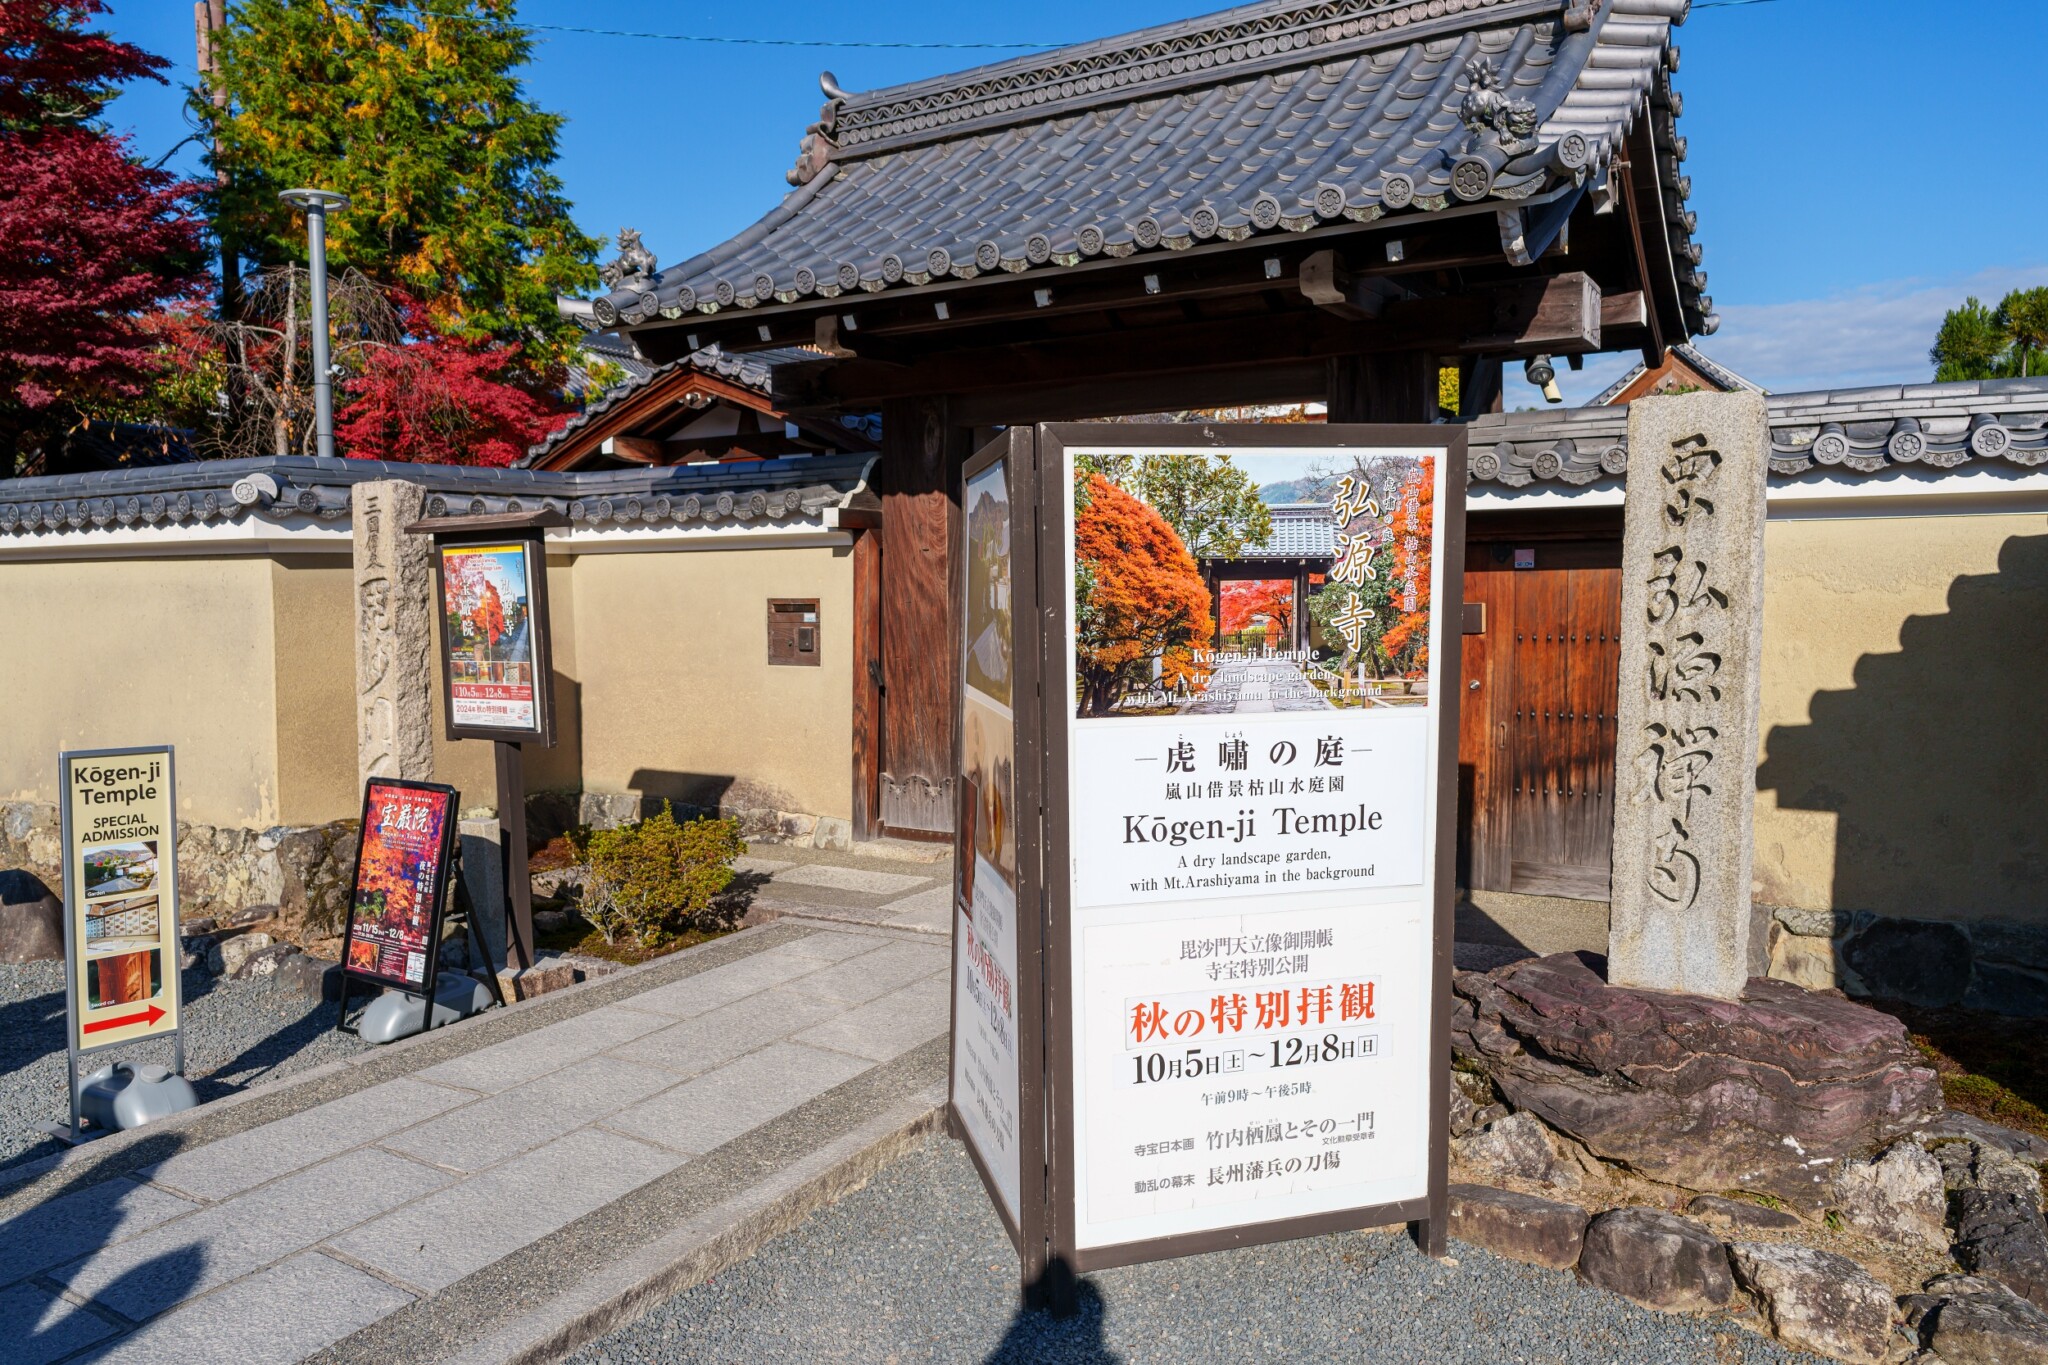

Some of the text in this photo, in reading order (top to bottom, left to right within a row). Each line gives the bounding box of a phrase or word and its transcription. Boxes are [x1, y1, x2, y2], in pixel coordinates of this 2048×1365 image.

[1331, 475, 1380, 654] 弘源寺
[1193, 646, 1320, 665] Kōgen-ji Temple
[1178, 674, 1187, 685] A
[1192, 672, 1214, 685] dry
[1220, 671, 1283, 684] landscape
[1126, 693, 1155, 705] with
[1268, 689, 1280, 699] in
[1284, 689, 1304, 699] the
[1309, 686, 1382, 699] background
[74, 762, 161, 784] Kōgen-ji
[80, 784, 157, 806] Temple
[1165, 775, 1344, 801] 嵐山借景枯山水庭園
[82, 825, 160, 843] ADMISSION
[93, 813, 147, 829] SPECIAL
[1122, 804, 1383, 847] Kōgen-ji Temple
[1178, 848, 1331, 868] A dry landscape garden,
[1130, 864, 1375, 893] with Mt.Arashiyama in the background
[1179, 928, 1333, 961] 毘沙門天立像御開帳
[1205, 954, 1309, 982] 寺宝特別公開
[1130, 981, 1376, 1043] 秋の特別拝観
[1134, 1111, 1375, 1157] 寺宝日本画 竹内栖鳳とその一門
[1134, 1150, 1341, 1194] 動乱の幕末 長州藩兵の刀傷
